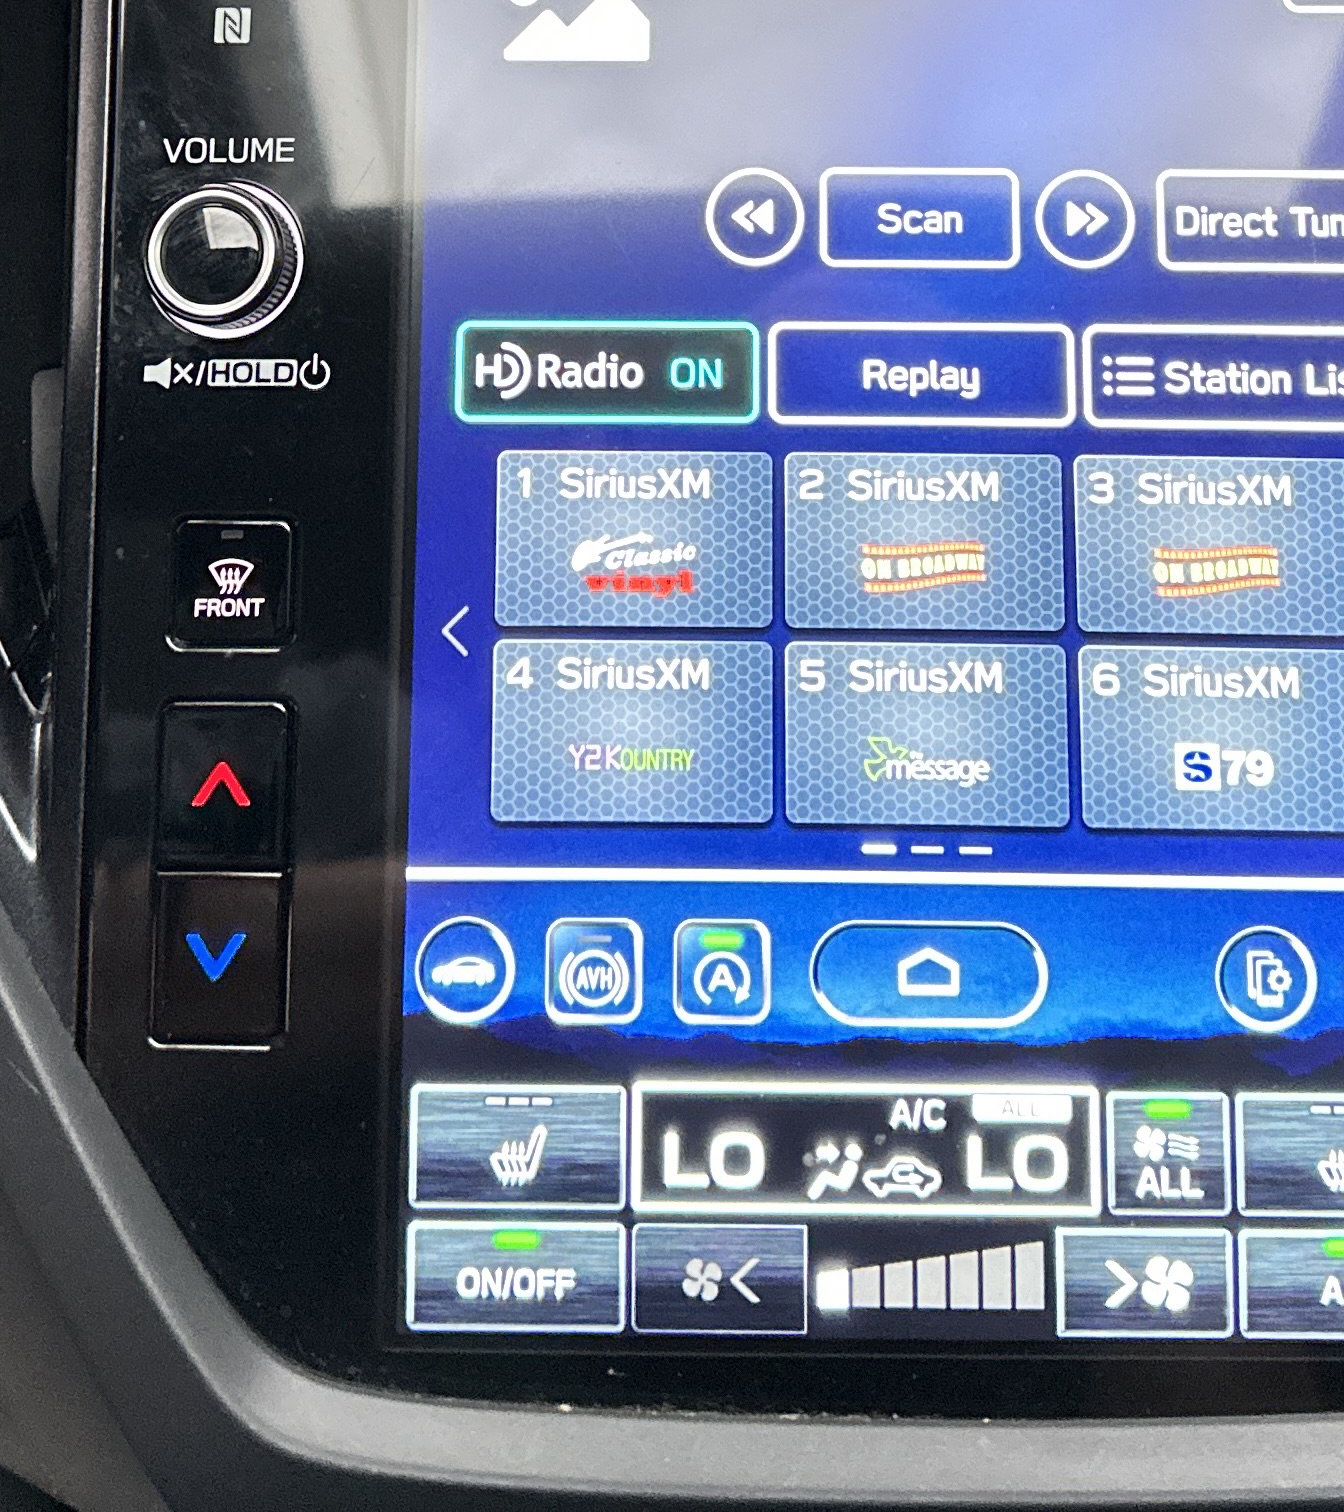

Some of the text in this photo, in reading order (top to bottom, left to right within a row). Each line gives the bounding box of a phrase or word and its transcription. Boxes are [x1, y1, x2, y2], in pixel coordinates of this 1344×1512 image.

[163, 137, 296, 163] VOLUME
[876, 202, 964, 235] Scan
[1175, 205, 1279, 239] Direct
[537, 351, 645, 389] Radio
[669, 356, 724, 391] ON
[861, 358, 981, 399] Replay
[1163, 361, 1292, 397] Station
[517, 466, 711, 500] 1 SiriusXM
[798, 468, 1000, 502] 2 SiriusXM
[1087, 471, 1293, 507] 3 SiriusXM
[606, 541, 697, 570] Classic
[896, 553, 986, 579] BROADWAY
[1189, 557, 1279, 583] BROADWAY
[194, 597, 266, 618] FRONT
[506, 656, 710, 691] 4 SiriusXM
[799, 659, 1003, 694] 5 SiriusXM
[1092, 662, 1300, 700] 6 SiriusXM
[575, 965, 613, 992] AVH
[888, 1097, 948, 1131] A/C
[662, 1126, 766, 1190] LO
[965, 1133, 1070, 1193] LO
[1135, 1165, 1205, 1200] ALL
[456, 1266, 577, 1301] ON/OFF
